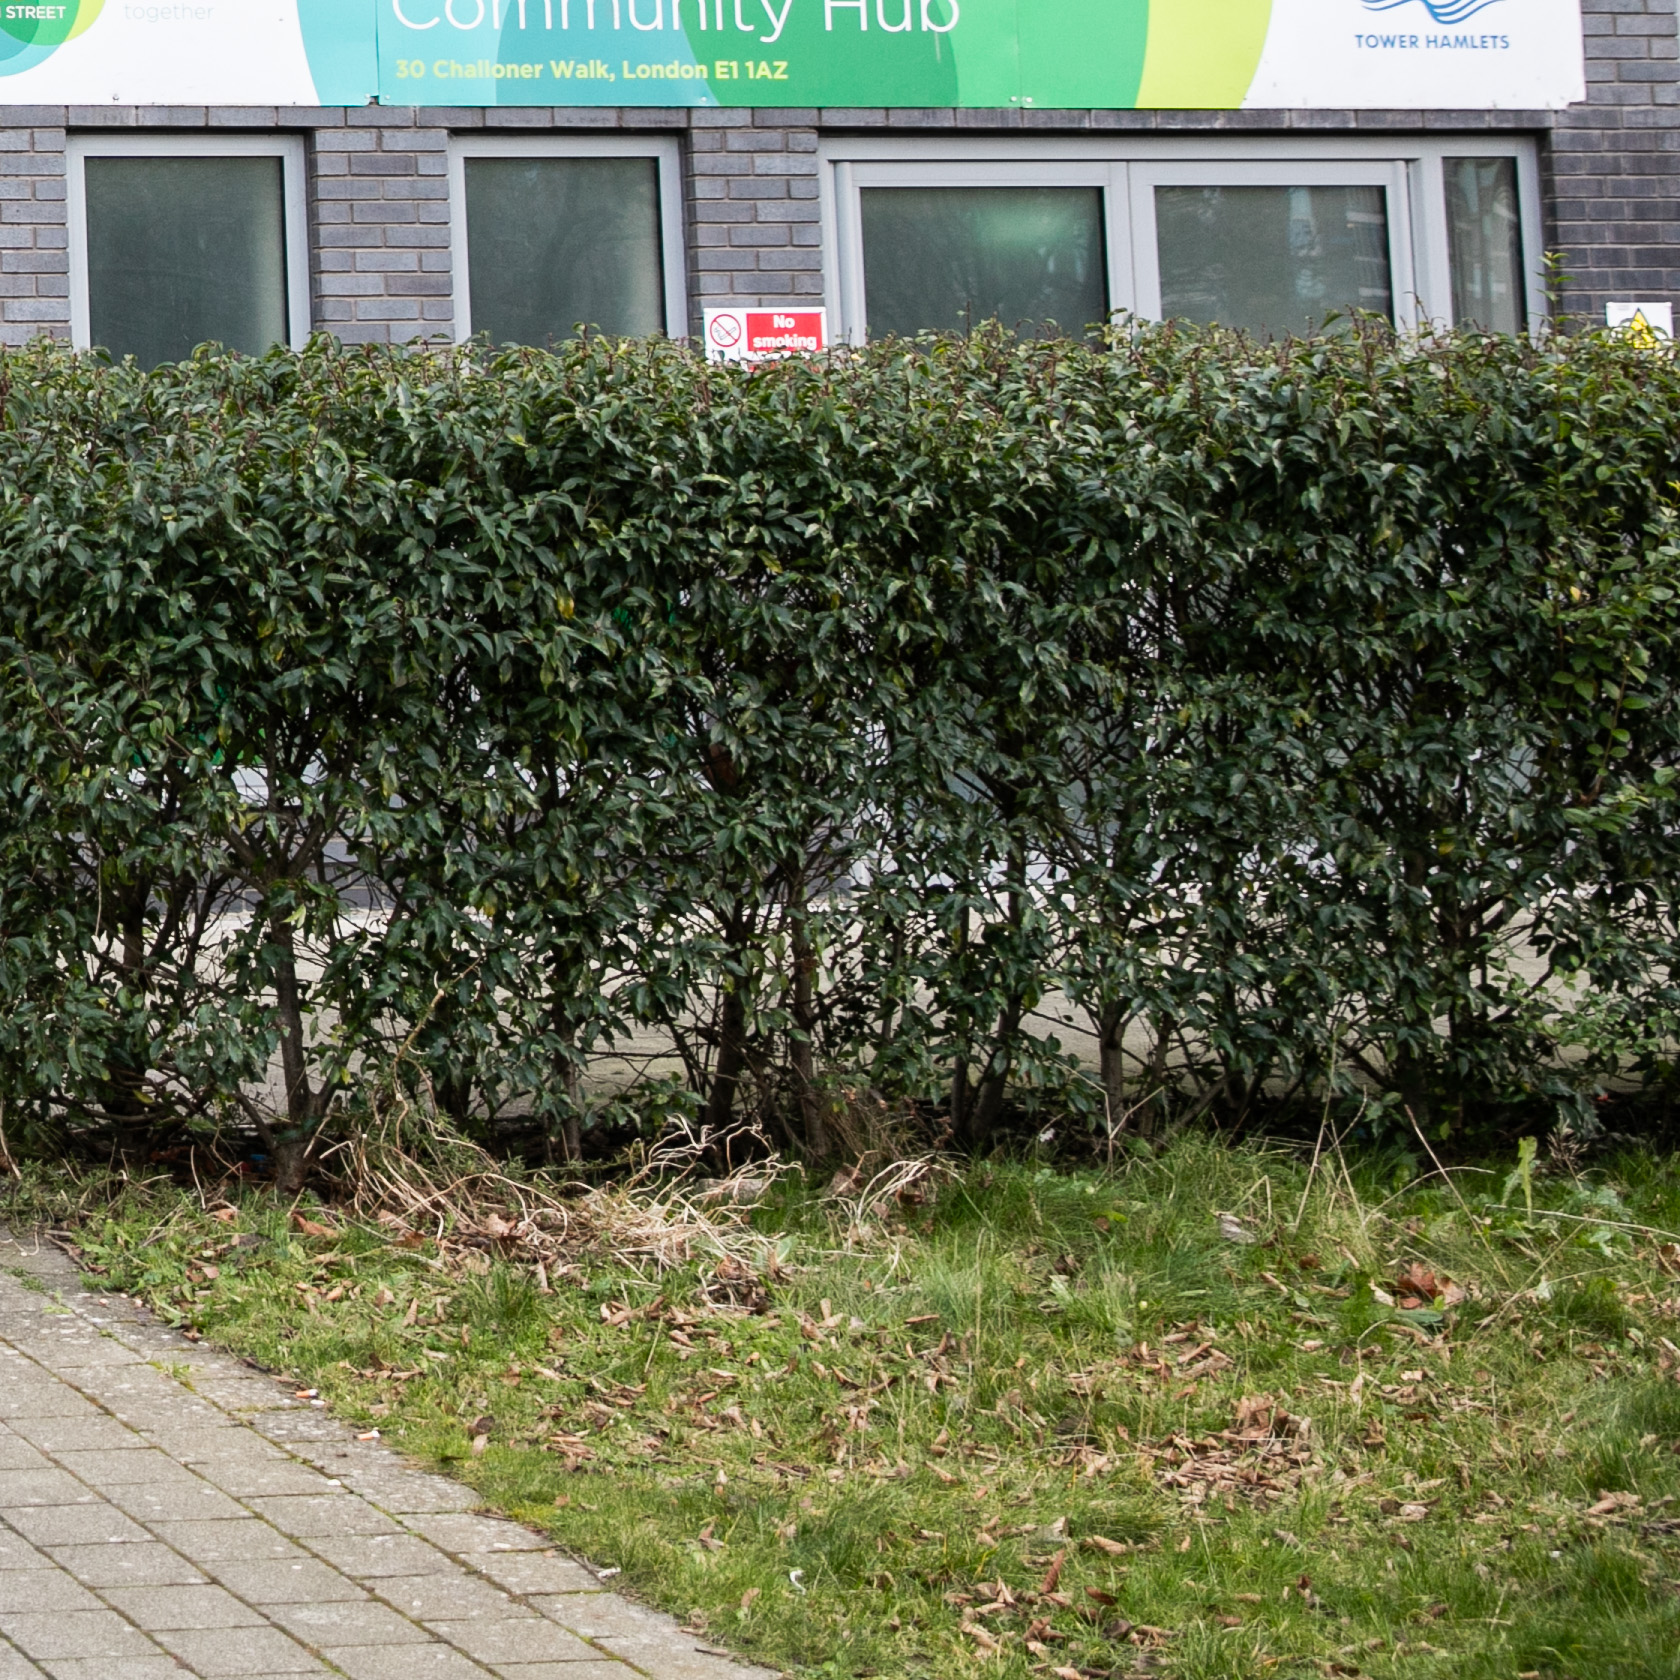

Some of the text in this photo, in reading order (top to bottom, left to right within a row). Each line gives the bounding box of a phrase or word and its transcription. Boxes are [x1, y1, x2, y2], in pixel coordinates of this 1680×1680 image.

[5, 5, 67, 20] STREET
[124, 3, 215, 23] together
[1354, 34, 1510, 50] TOWER HAMLETS
[395, 59, 789, 83] 30 Challoner Walk, London E1 1AZ
[773, 314, 796, 329] No
[752, 334, 817, 351] smoking
